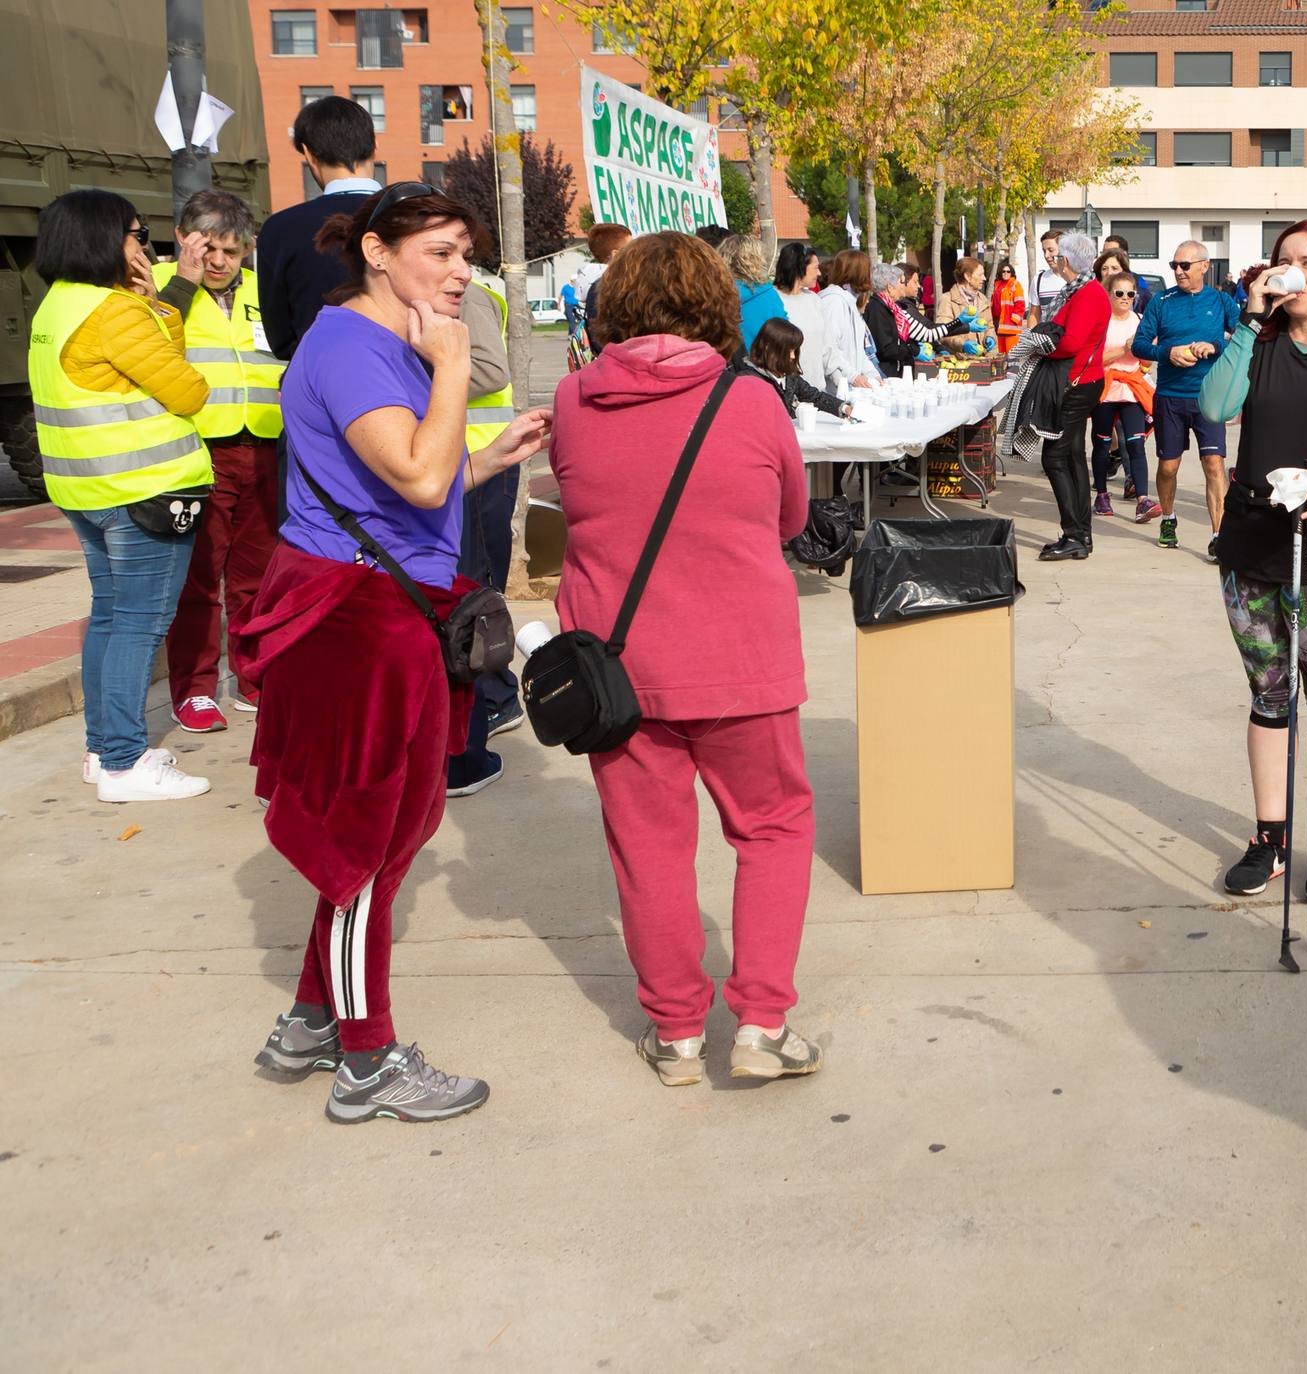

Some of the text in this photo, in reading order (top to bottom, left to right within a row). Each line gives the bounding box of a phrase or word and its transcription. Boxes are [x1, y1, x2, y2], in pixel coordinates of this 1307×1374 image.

[617, 101, 694, 182] ASPACE
[593, 164, 718, 237] EN MARCHA
